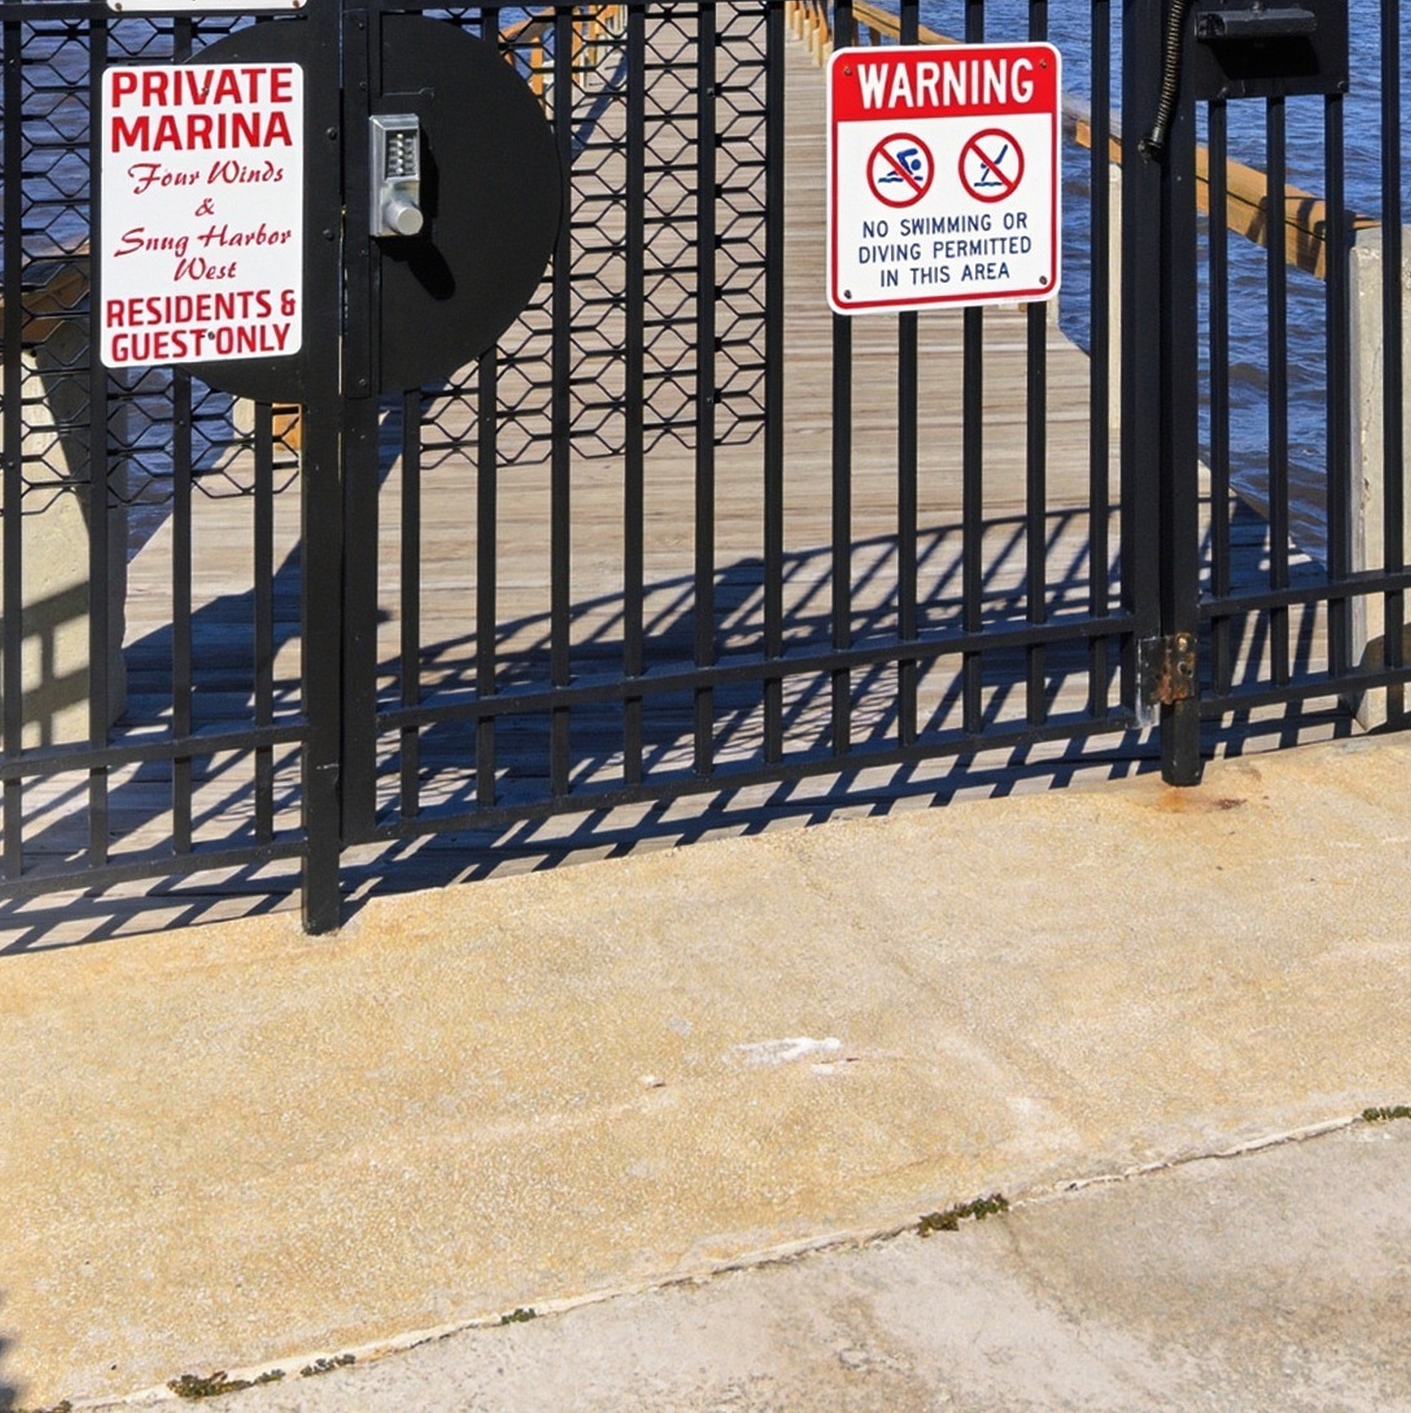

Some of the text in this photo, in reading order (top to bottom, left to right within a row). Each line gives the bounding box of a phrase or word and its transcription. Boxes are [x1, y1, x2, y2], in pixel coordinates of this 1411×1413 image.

[111, 67, 293, 108] PRIVATE
[857, 57, 1034, 110] WARNING
[111, 111, 293, 153] MARINA
[128, 160, 283, 195] Four Winds
[195, 197, 215, 216] &
[113, 223, 292, 258] Snug Harbor
[863, 212, 1028, 239] NO SWIMMING OR
[859, 236, 1031, 264] DIVING PERMITTED
[173, 257, 237, 282] West
[880, 262, 1010, 288] IN THIS AREA
[107, 289, 296, 328] RESIDENTS &
[111, 323, 291, 363] GUEST ONLY
